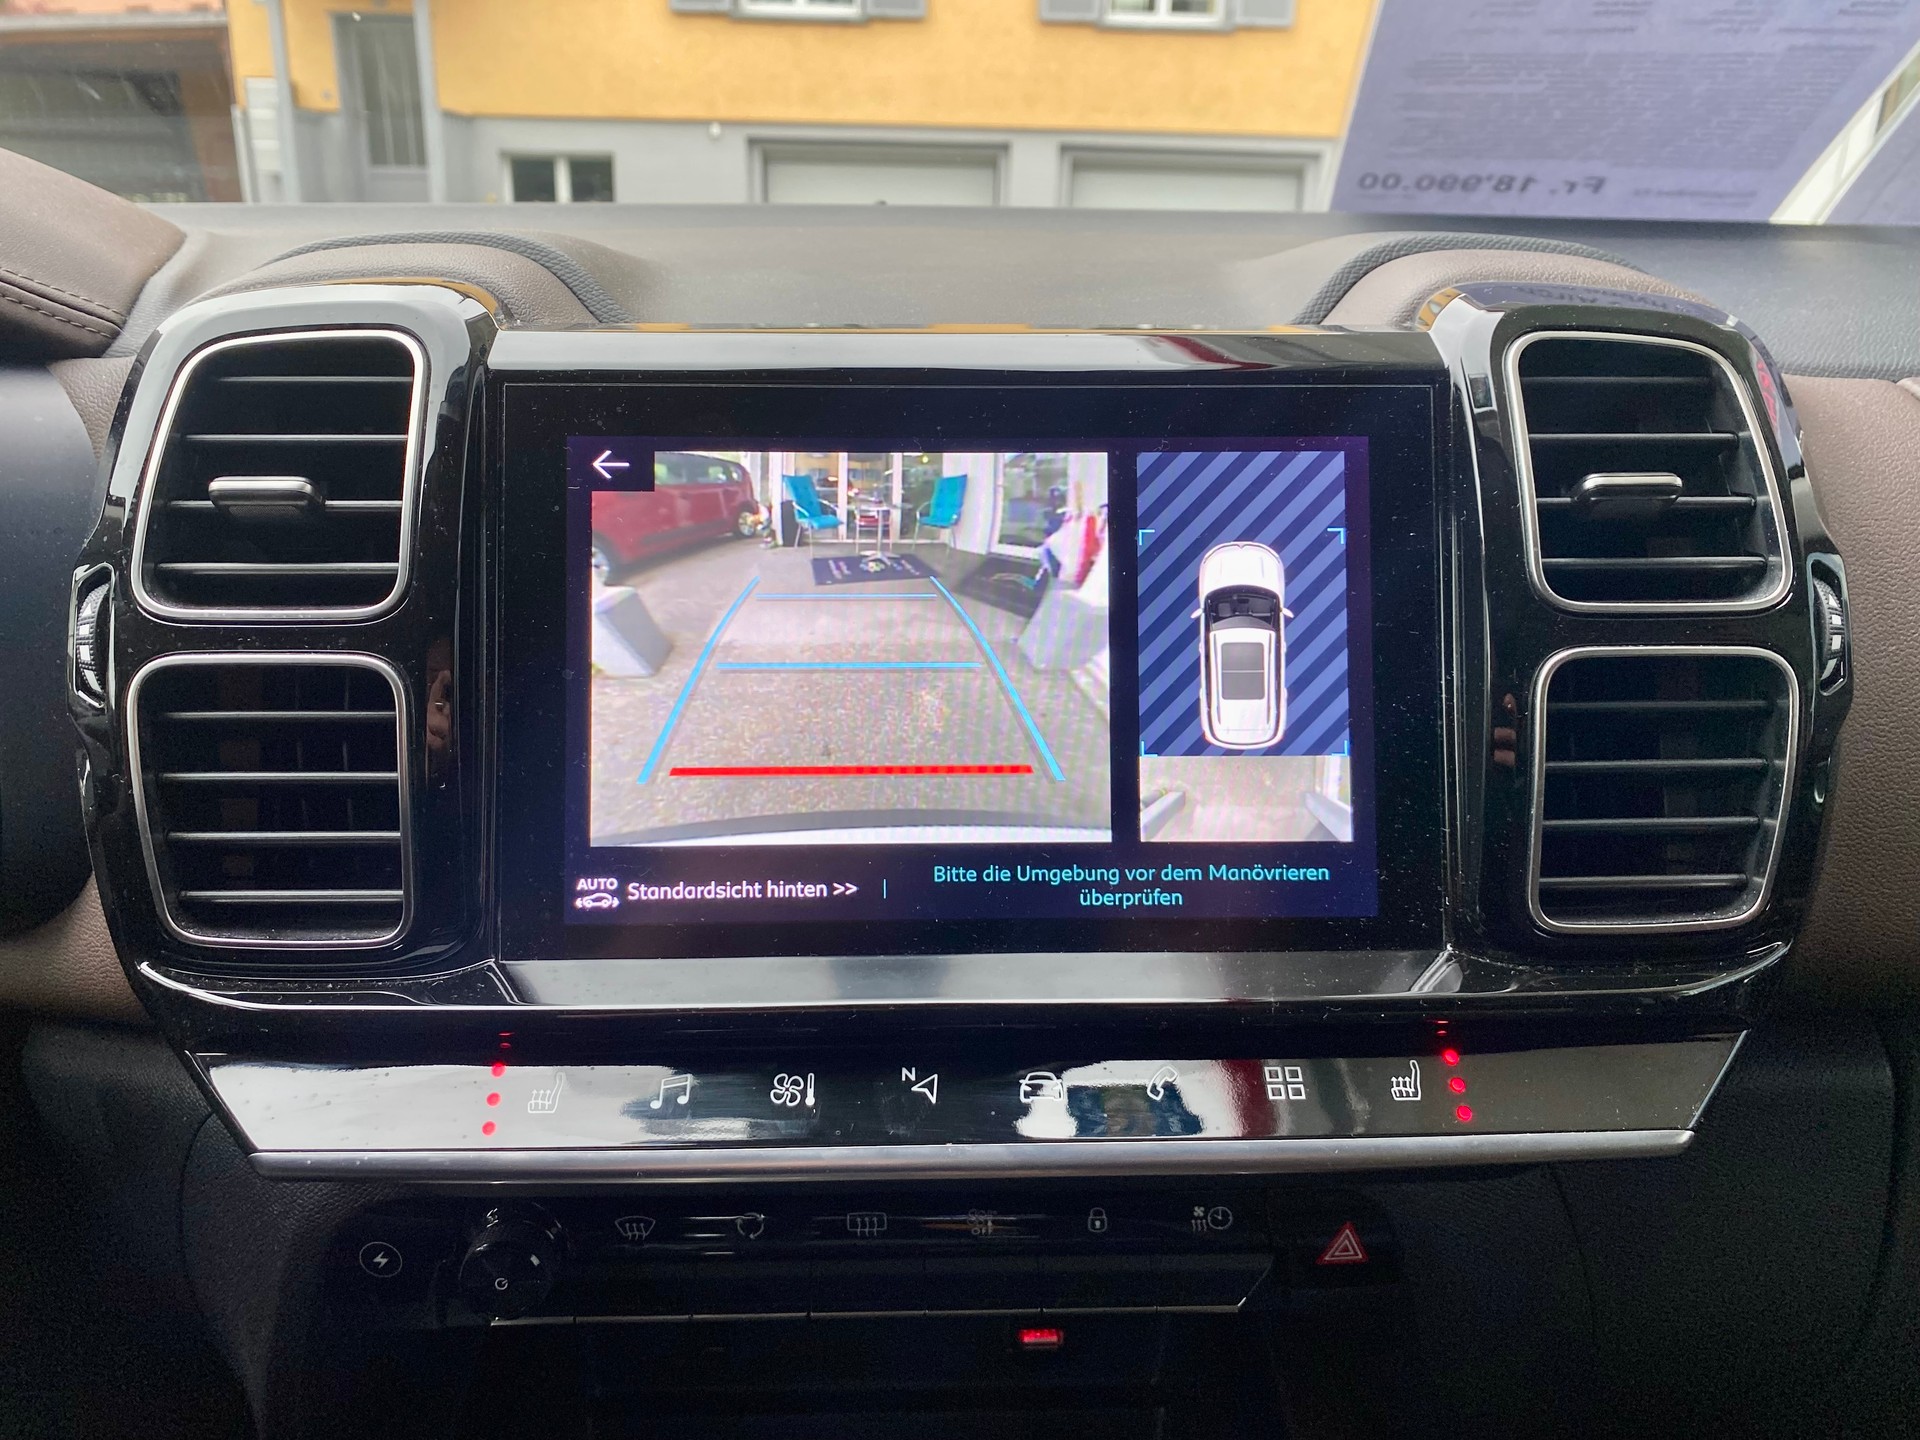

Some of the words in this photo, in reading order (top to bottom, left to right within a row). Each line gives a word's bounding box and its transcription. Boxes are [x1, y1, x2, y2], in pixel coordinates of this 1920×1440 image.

[576, 877, 619, 891] AUTO
[933, 865, 978, 883] Bitte
[982, 864, 1012, 883] die
[1017, 864, 1120, 886] Umgebung
[1125, 867, 1155, 881] vor
[1160, 863, 1203, 881] dem
[1208, 863, 1331, 882] Manövrieren
[627, 880, 763, 901] Standardsicht
[766, 880, 828, 898] hinten
[1079, 887, 1184, 910] überprüfen
[901, 1066, 916, 1081] N
